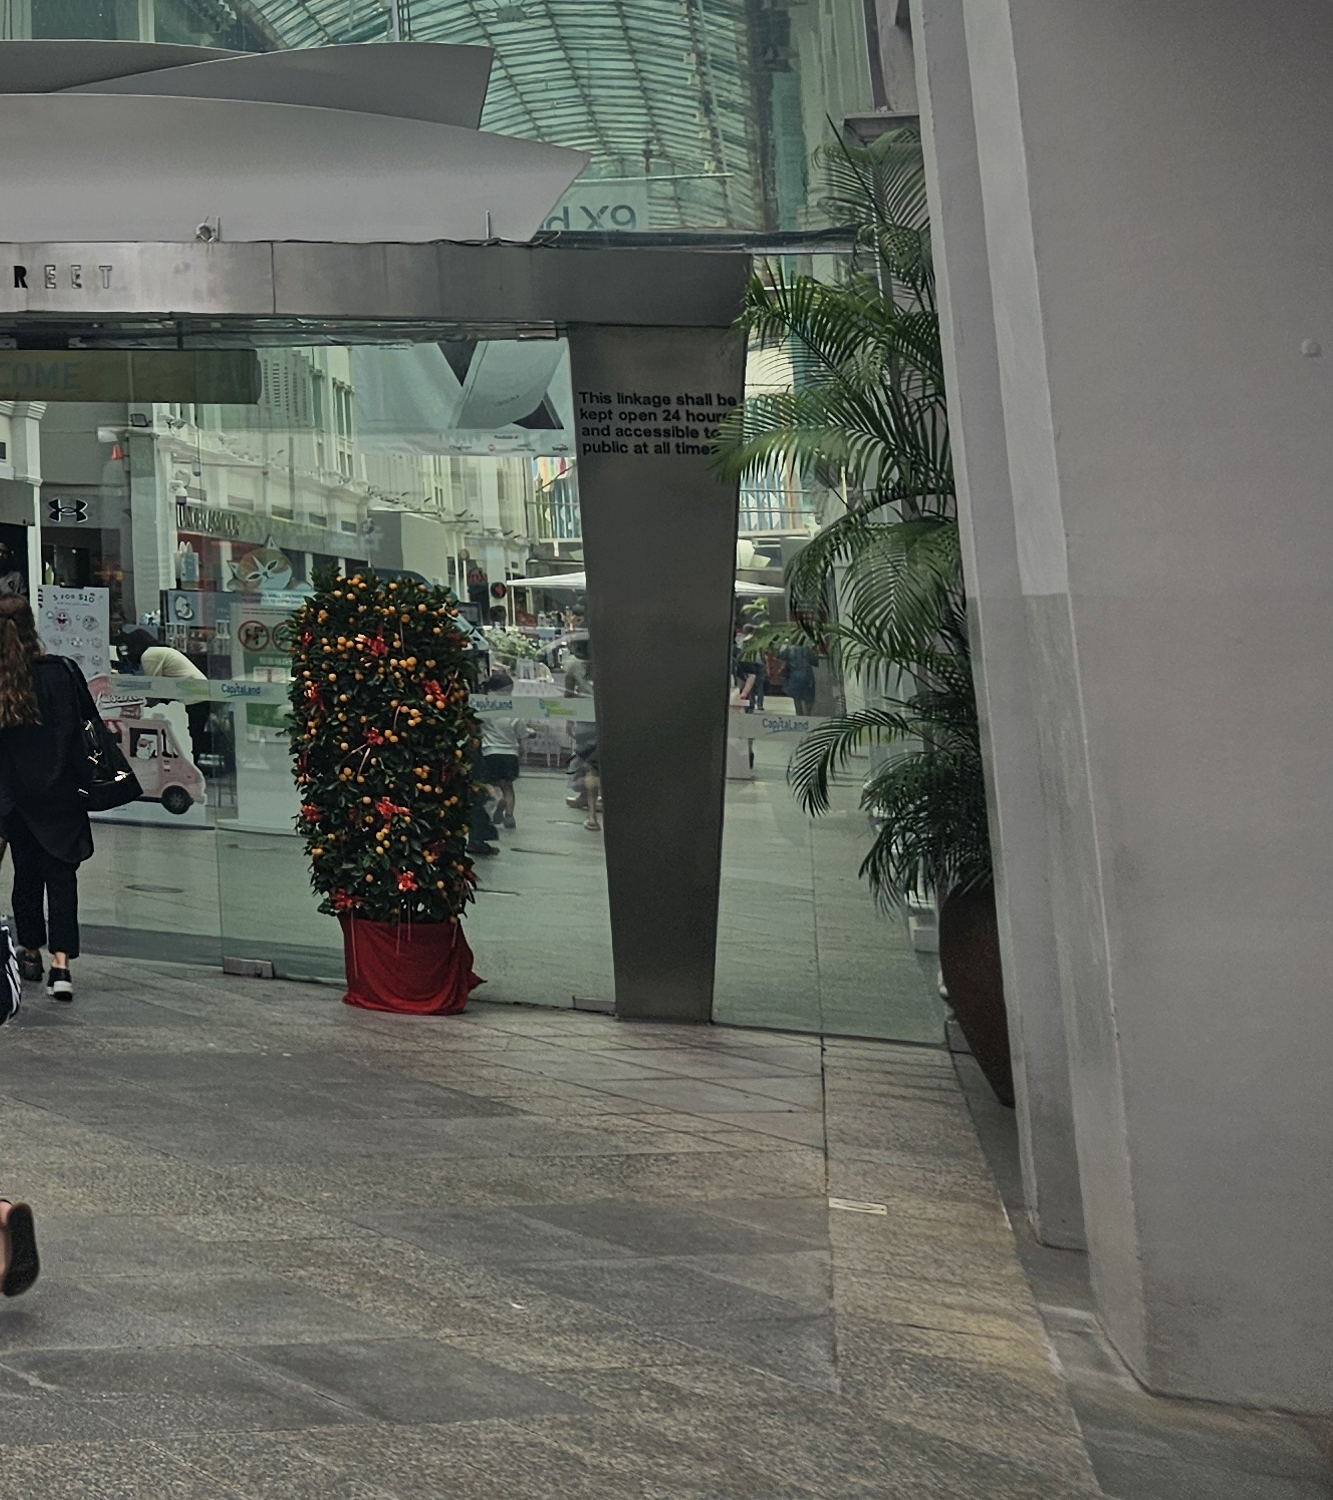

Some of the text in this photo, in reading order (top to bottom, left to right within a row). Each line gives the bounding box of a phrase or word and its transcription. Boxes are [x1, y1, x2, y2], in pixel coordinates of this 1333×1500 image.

[578, 391, 738, 408] This linkage shall be
[580, 408, 729, 424] kept open 24 hour
[581, 424, 611, 437] and
[615, 426, 699, 438] accessible
[583, 440, 629, 456] public
[633, 442, 649, 454] at
[653, 442, 671, 455] all
[221, 682, 261, 697] CapitaLand
[762, 717, 809, 732] CapitaLand
